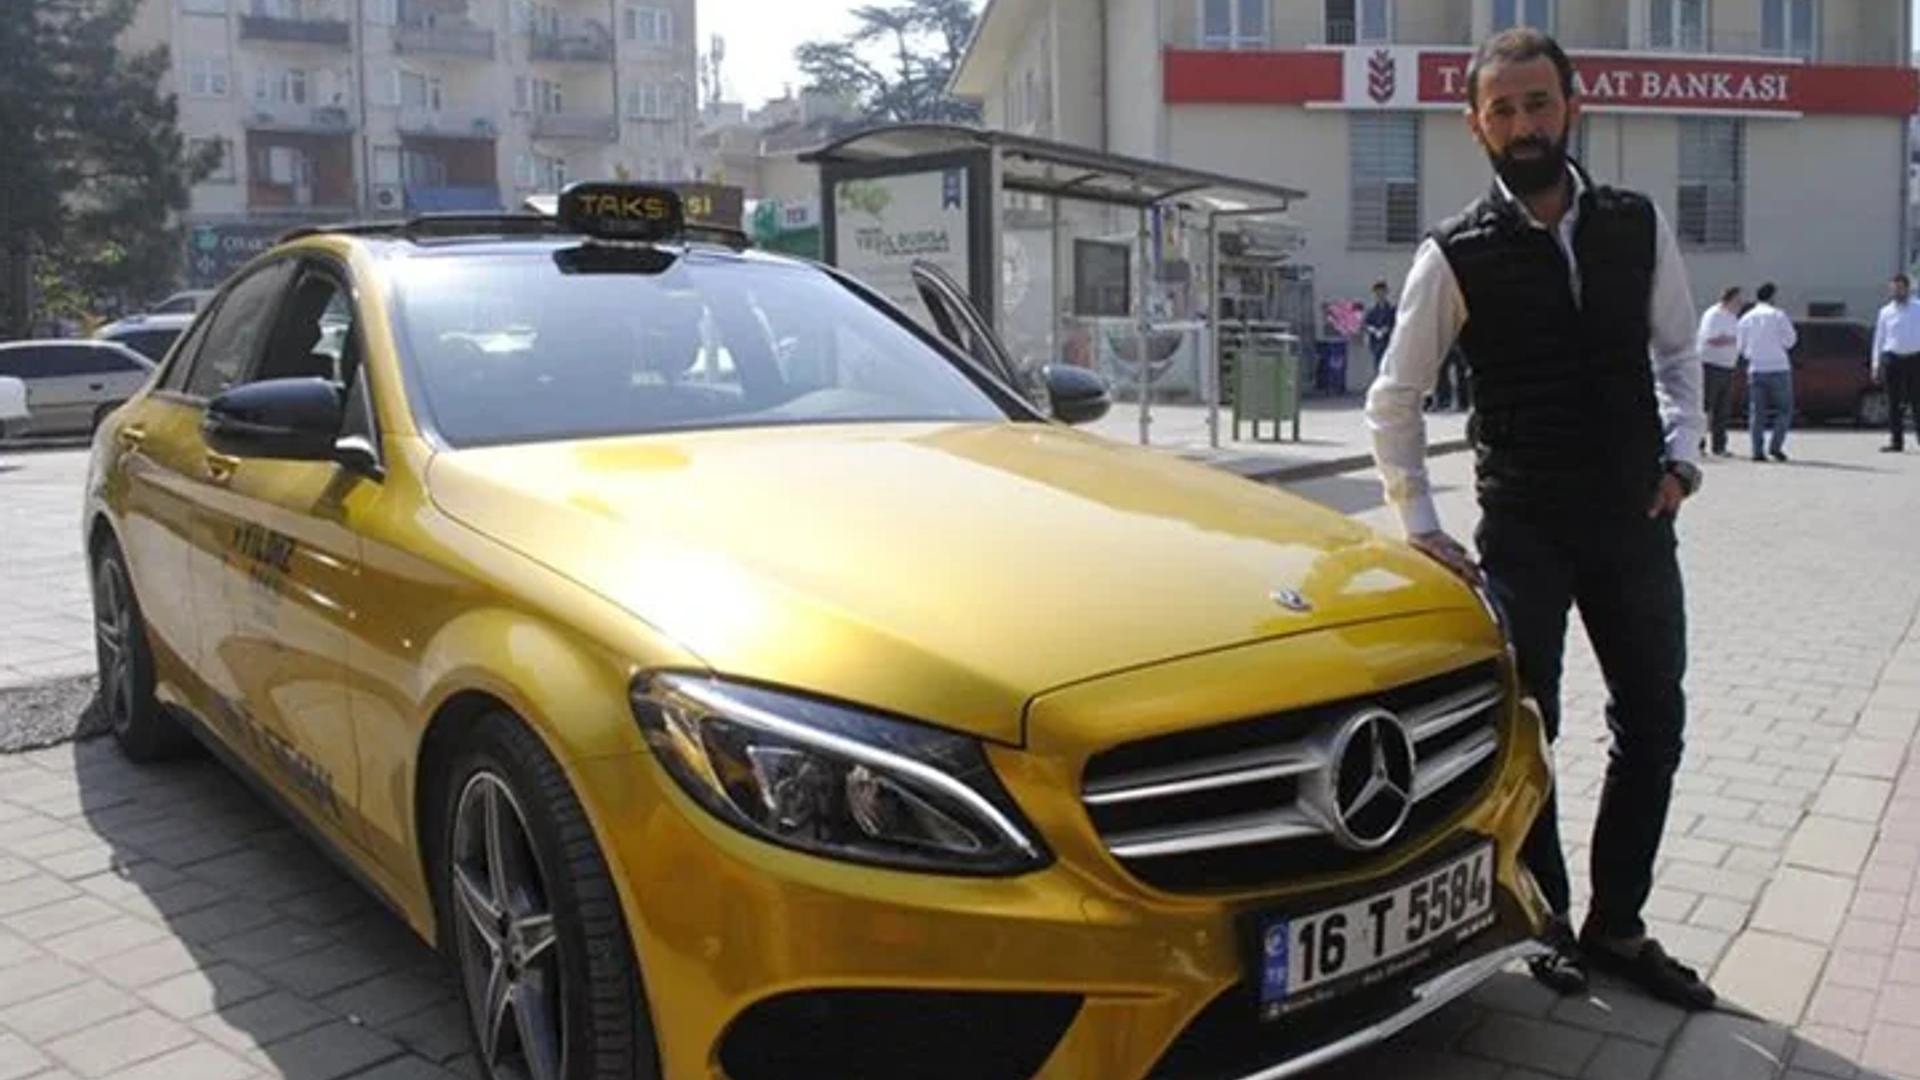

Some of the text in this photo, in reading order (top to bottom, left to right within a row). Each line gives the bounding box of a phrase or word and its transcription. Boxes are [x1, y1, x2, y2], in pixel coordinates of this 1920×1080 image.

[1642, 72, 1790, 101] BANKASI
[1298, 912, 1347, 983] 16
[1367, 895, 1394, 958] T
[1406, 854, 1488, 942] 5584
